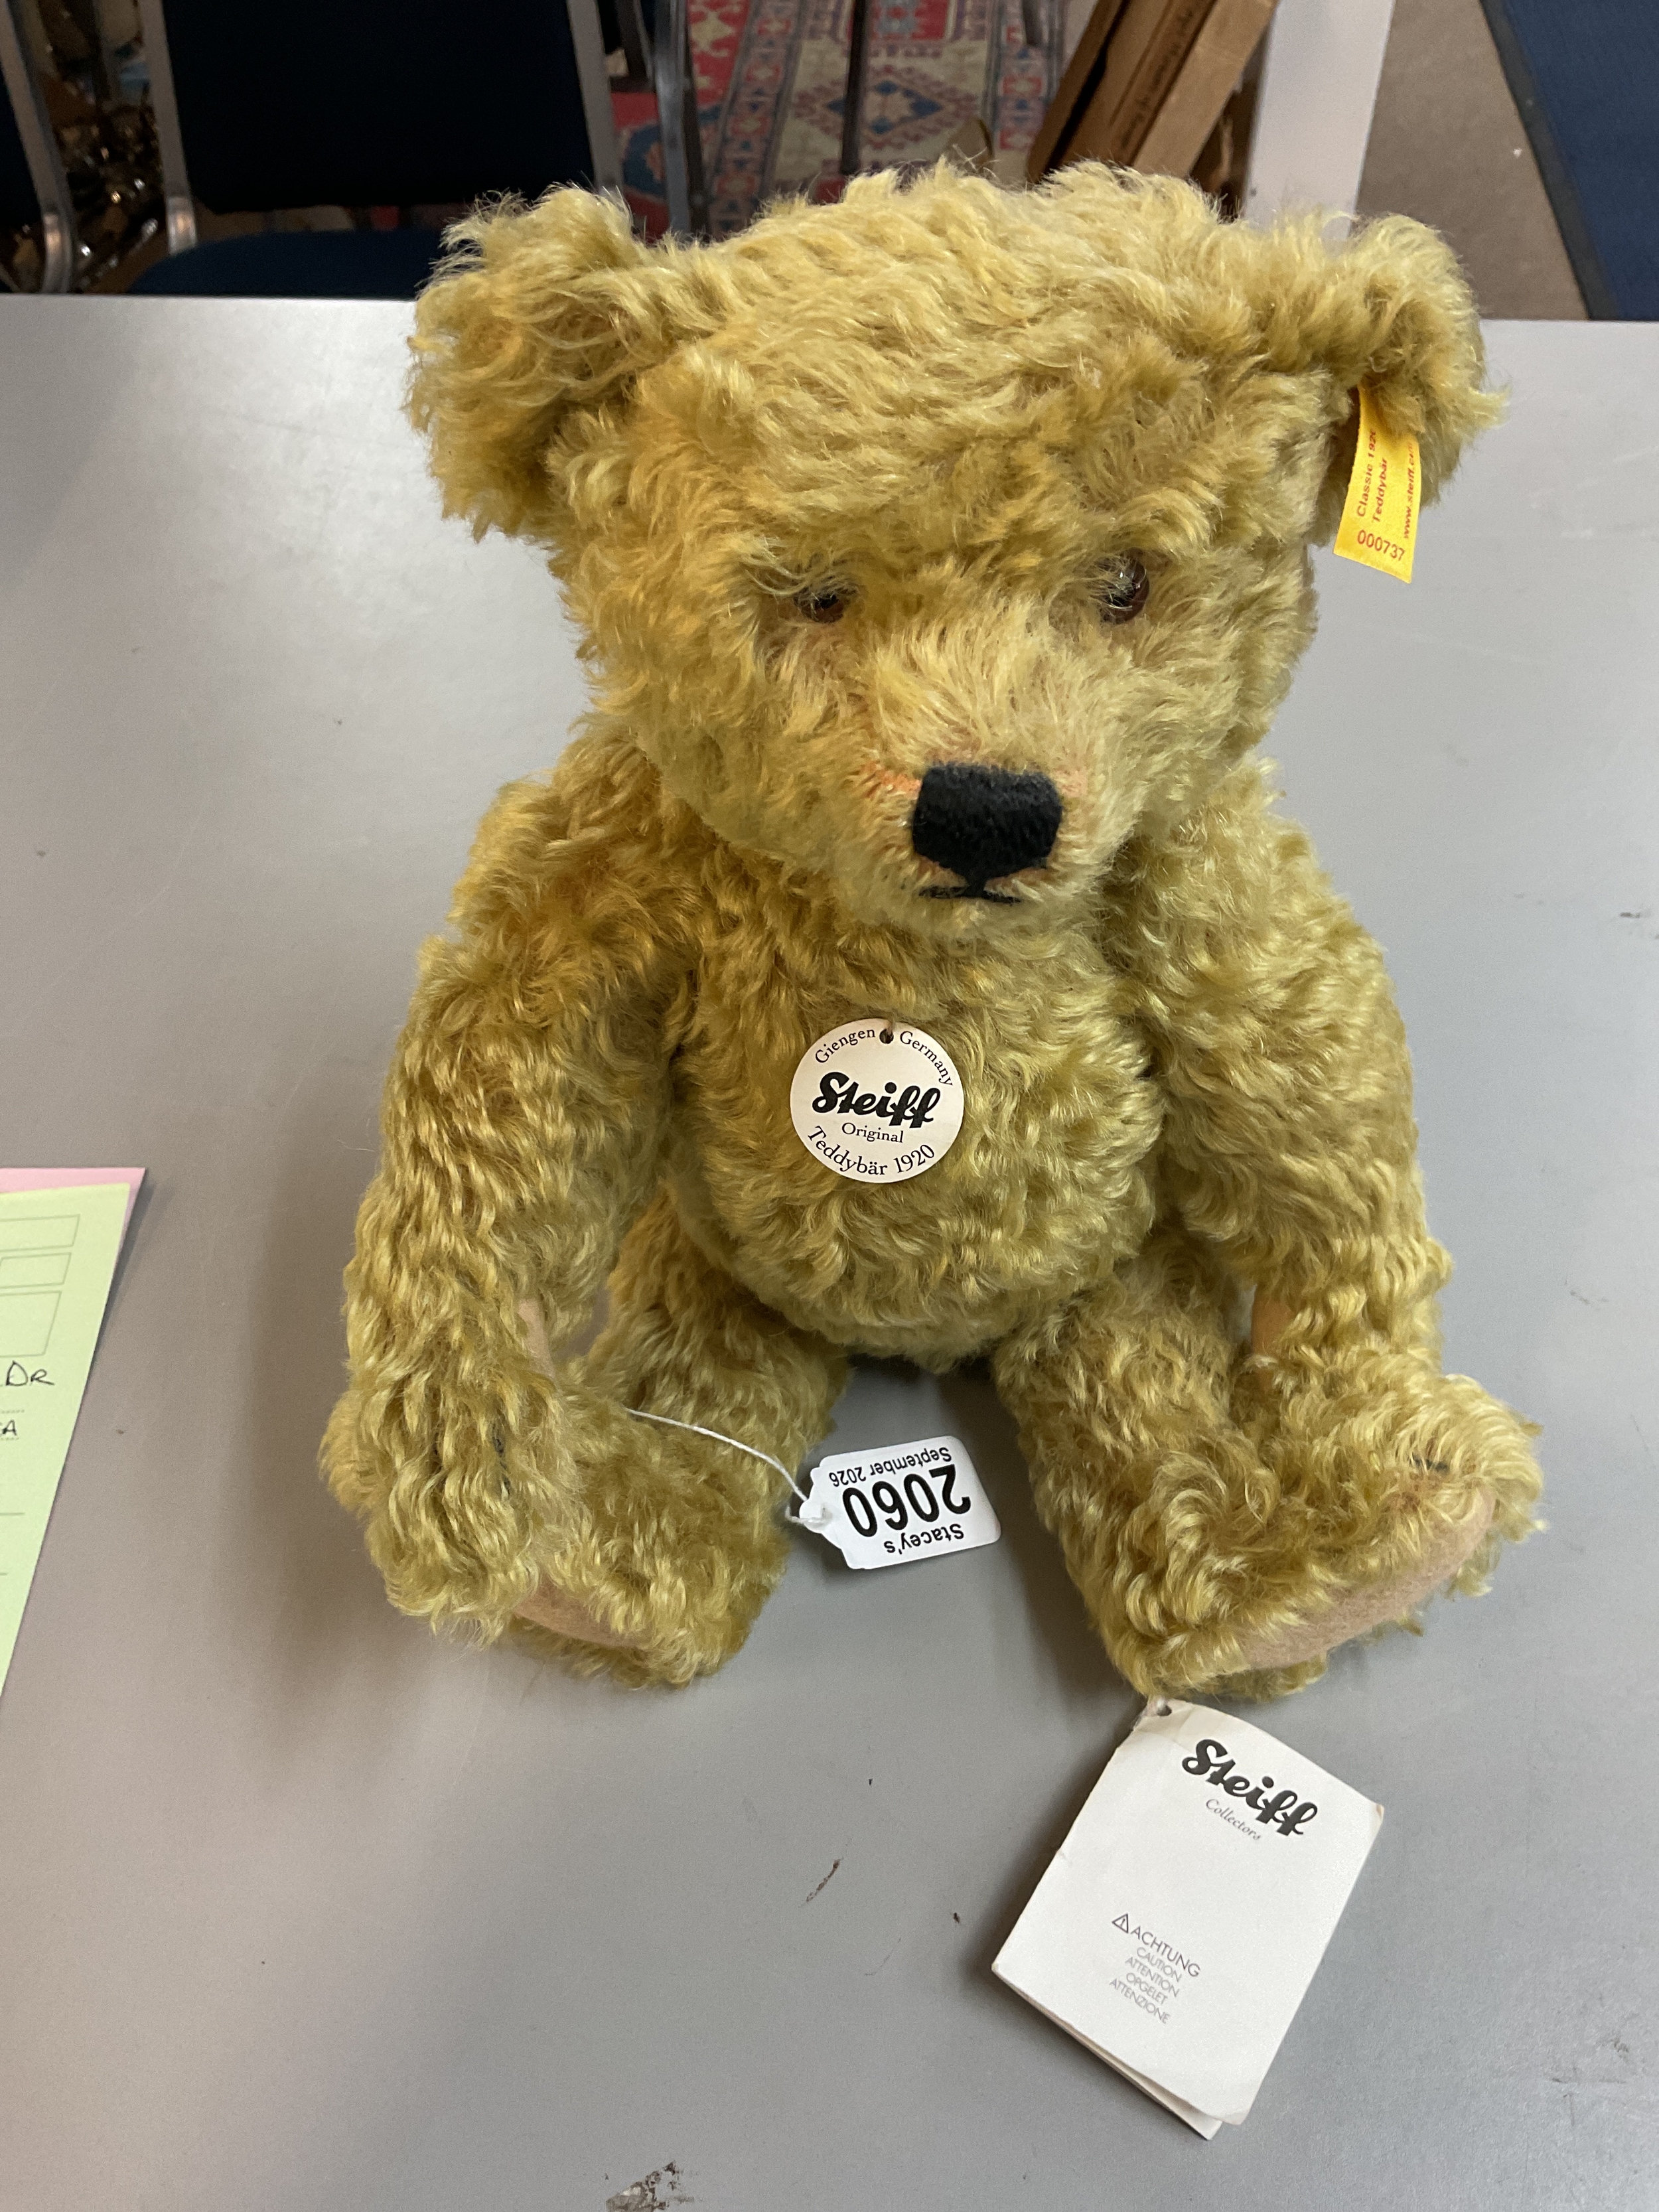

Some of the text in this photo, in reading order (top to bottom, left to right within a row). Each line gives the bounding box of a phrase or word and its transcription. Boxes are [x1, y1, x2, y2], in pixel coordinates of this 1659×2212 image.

[1356, 463, 1373, 517] Classic
[1372, 457, 1387, 523] Teddybär
[1357, 529, 1405, 561] 000737
[815, 1029, 954, 1086] Giengen Germany
[812, 1071, 941, 1129] Steiff
[808, 1125, 935, 1175] Teddybär 1920
[841, 1122, 904, 1143] Original
[829, 1447, 952, 1487] September 2026
[842, 1464, 972, 1538] 2060
[883, 1523, 964, 1555] Stacey's
[1182, 1739, 1318, 1836] Steiff
[1206, 1798, 1262, 1840] Collectors
[1130, 1925, 1201, 1978] ACHTUNG
[1137, 1947, 1183, 1983] CAUTION
[1125, 1956, 1181, 1998] ATTENTION
[1125, 1972, 1169, 2005] OPGELET
[1109, 1978, 1171, 2025] ATTENZIONE
